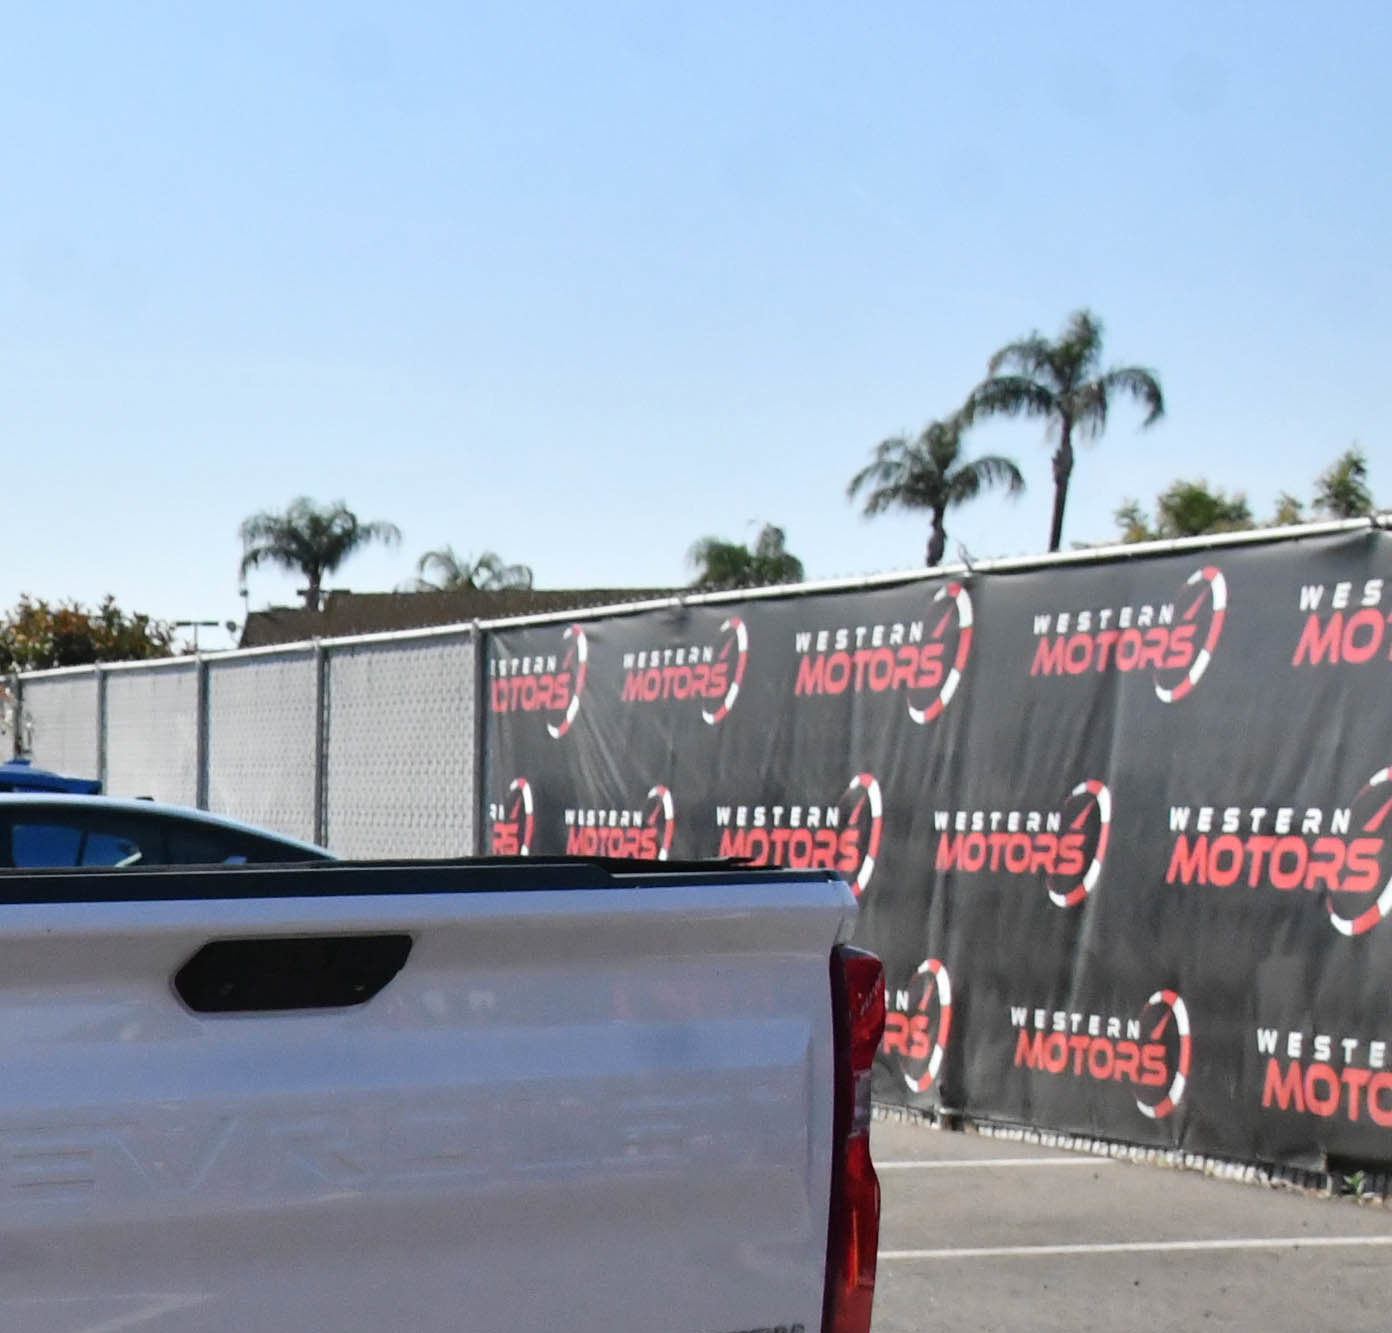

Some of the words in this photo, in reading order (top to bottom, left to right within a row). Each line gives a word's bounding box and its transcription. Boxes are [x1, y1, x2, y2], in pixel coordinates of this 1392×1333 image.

[796, 621, 923, 653] WESTERN
[1033, 604, 1174, 635] WESTERN
[490, 655, 557, 676] STERN
[623, 646, 713, 669] WESTERN
[1030, 624, 1197, 676] MOTORS
[621, 662, 728, 702] MOTORS
[794, 643, 945, 696] MOTORS
[491, 672, 571, 712] OTORS
[565, 809, 642, 827] WESTERN
[716, 806, 840, 827] WESTERN
[934, 811, 1061, 832] WESTERN
[1169, 806, 1351, 834] WESTERN
[566, 826, 657, 860] MOTORS
[719, 828, 861, 872] MOTORS
[936, 832, 1086, 875] MOTORS
[1167, 834, 1384, 892] MOTORS
[1011, 1006, 1140, 1040] WESTERN
[1015, 1028, 1168, 1086] MOTORS
[1257, 1027, 1386, 1068] WESTE
[1262, 1057, 1392, 1128] MOTO
